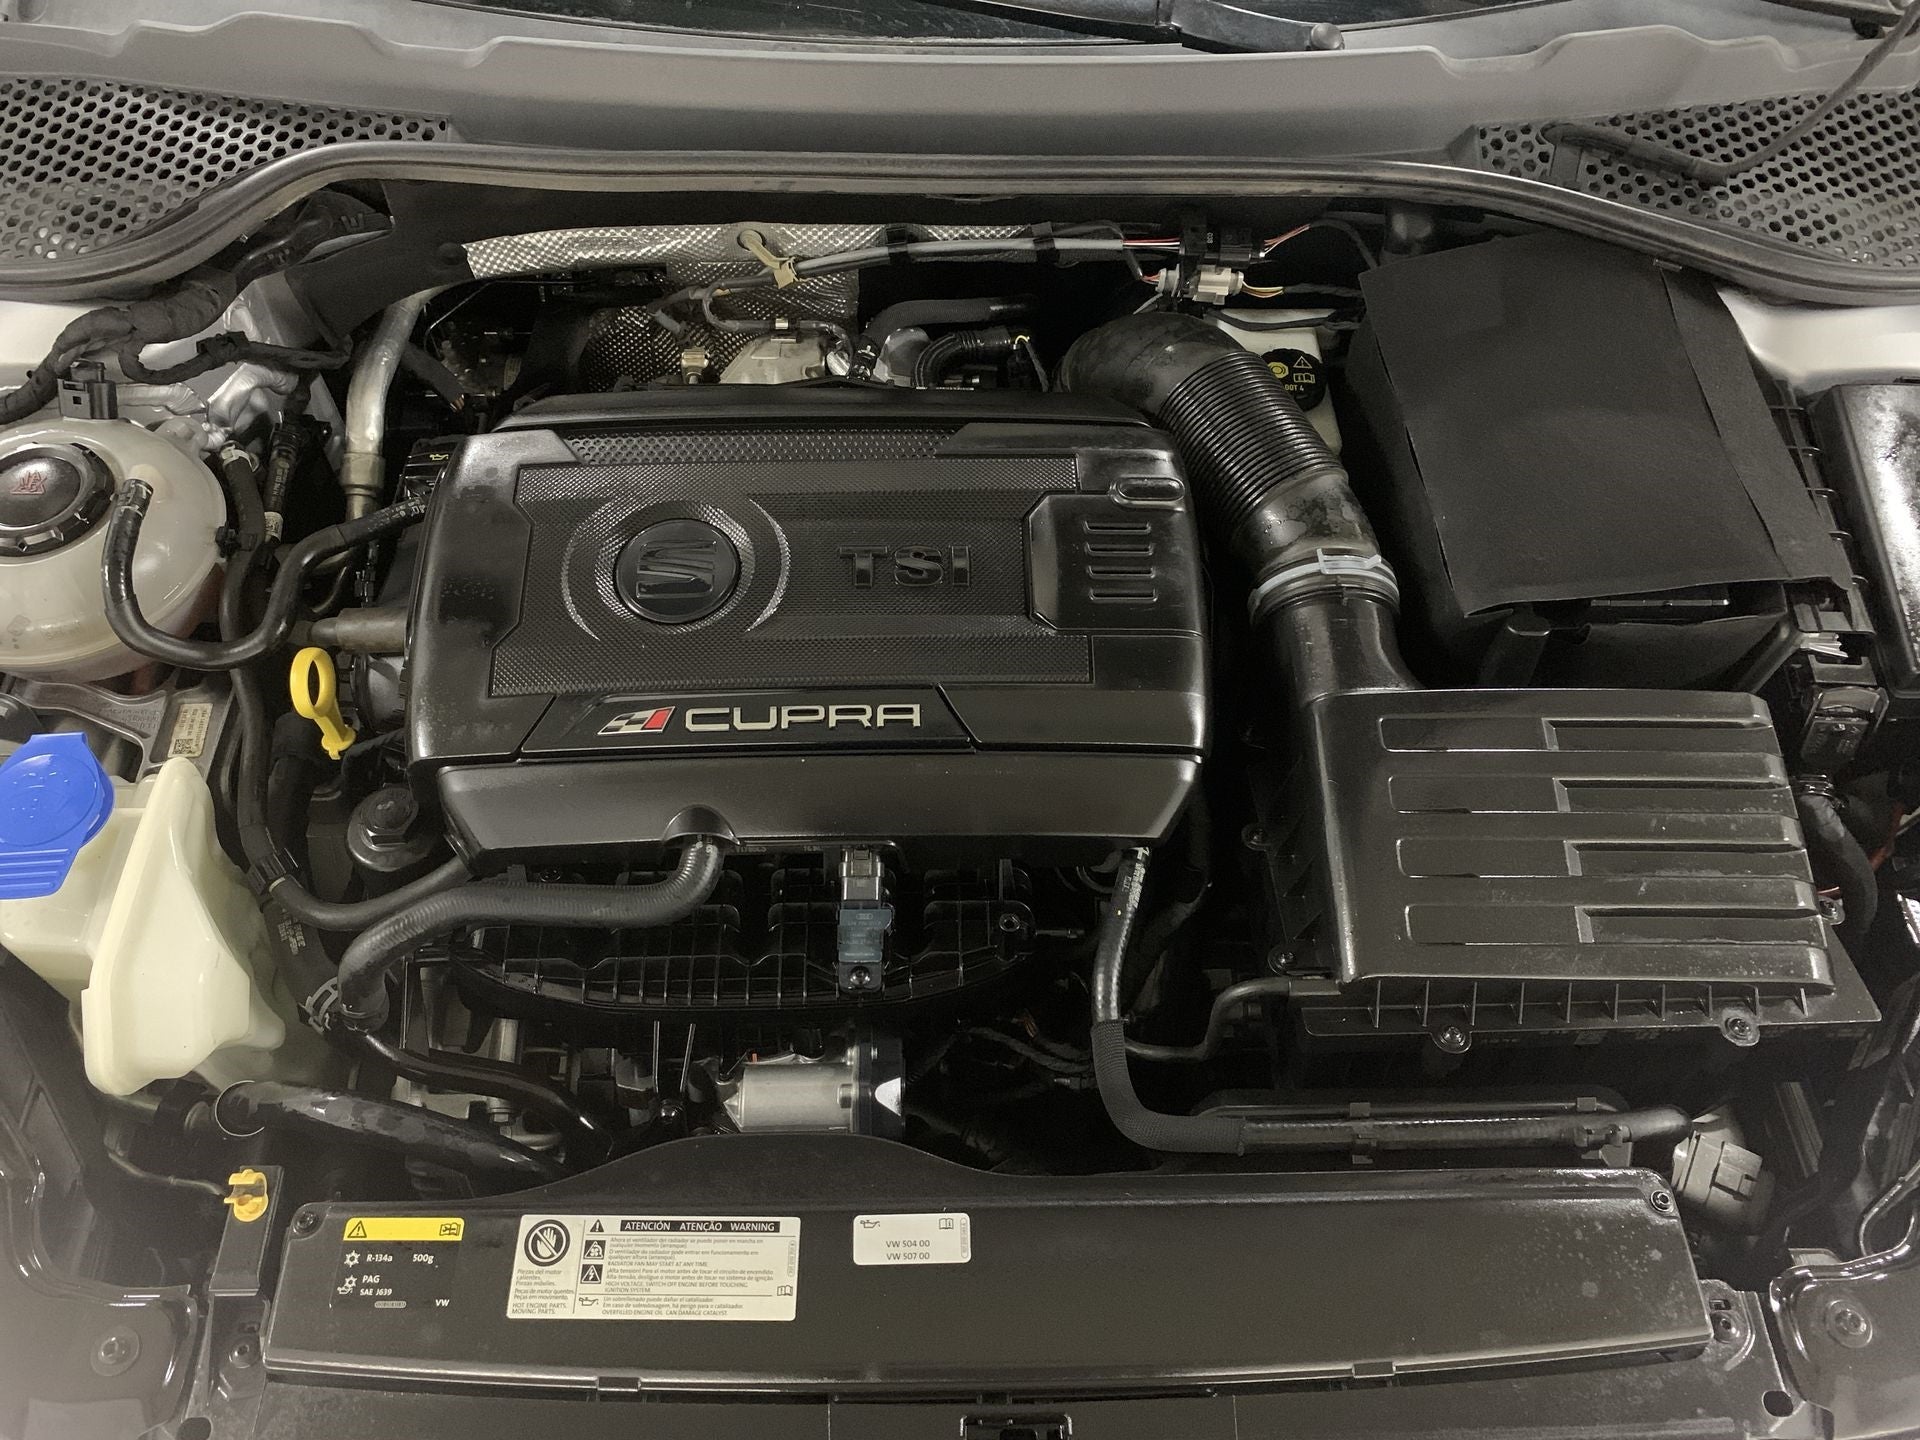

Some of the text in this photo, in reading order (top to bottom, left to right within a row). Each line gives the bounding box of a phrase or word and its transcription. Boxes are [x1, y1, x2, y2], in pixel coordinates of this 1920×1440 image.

[1284, 384, 1304, 392] DOT 4
[840, 545, 972, 588] TSI
[684, 703, 922, 733] CUPRA
[624, 1220, 775, 1233] ATENCIÓN ATENÇÃO WARNING
[885, 1240, 931, 1248] VW 504 00
[366, 1254, 434, 1265] R-134a 500g
[903, 1252, 917, 1260] 507
[918, 1252, 930, 1260] 00
[362, 1275, 381, 1284] PAG
[359, 1288, 393, 1296] SAE J639
[435, 1299, 450, 1307] VW
